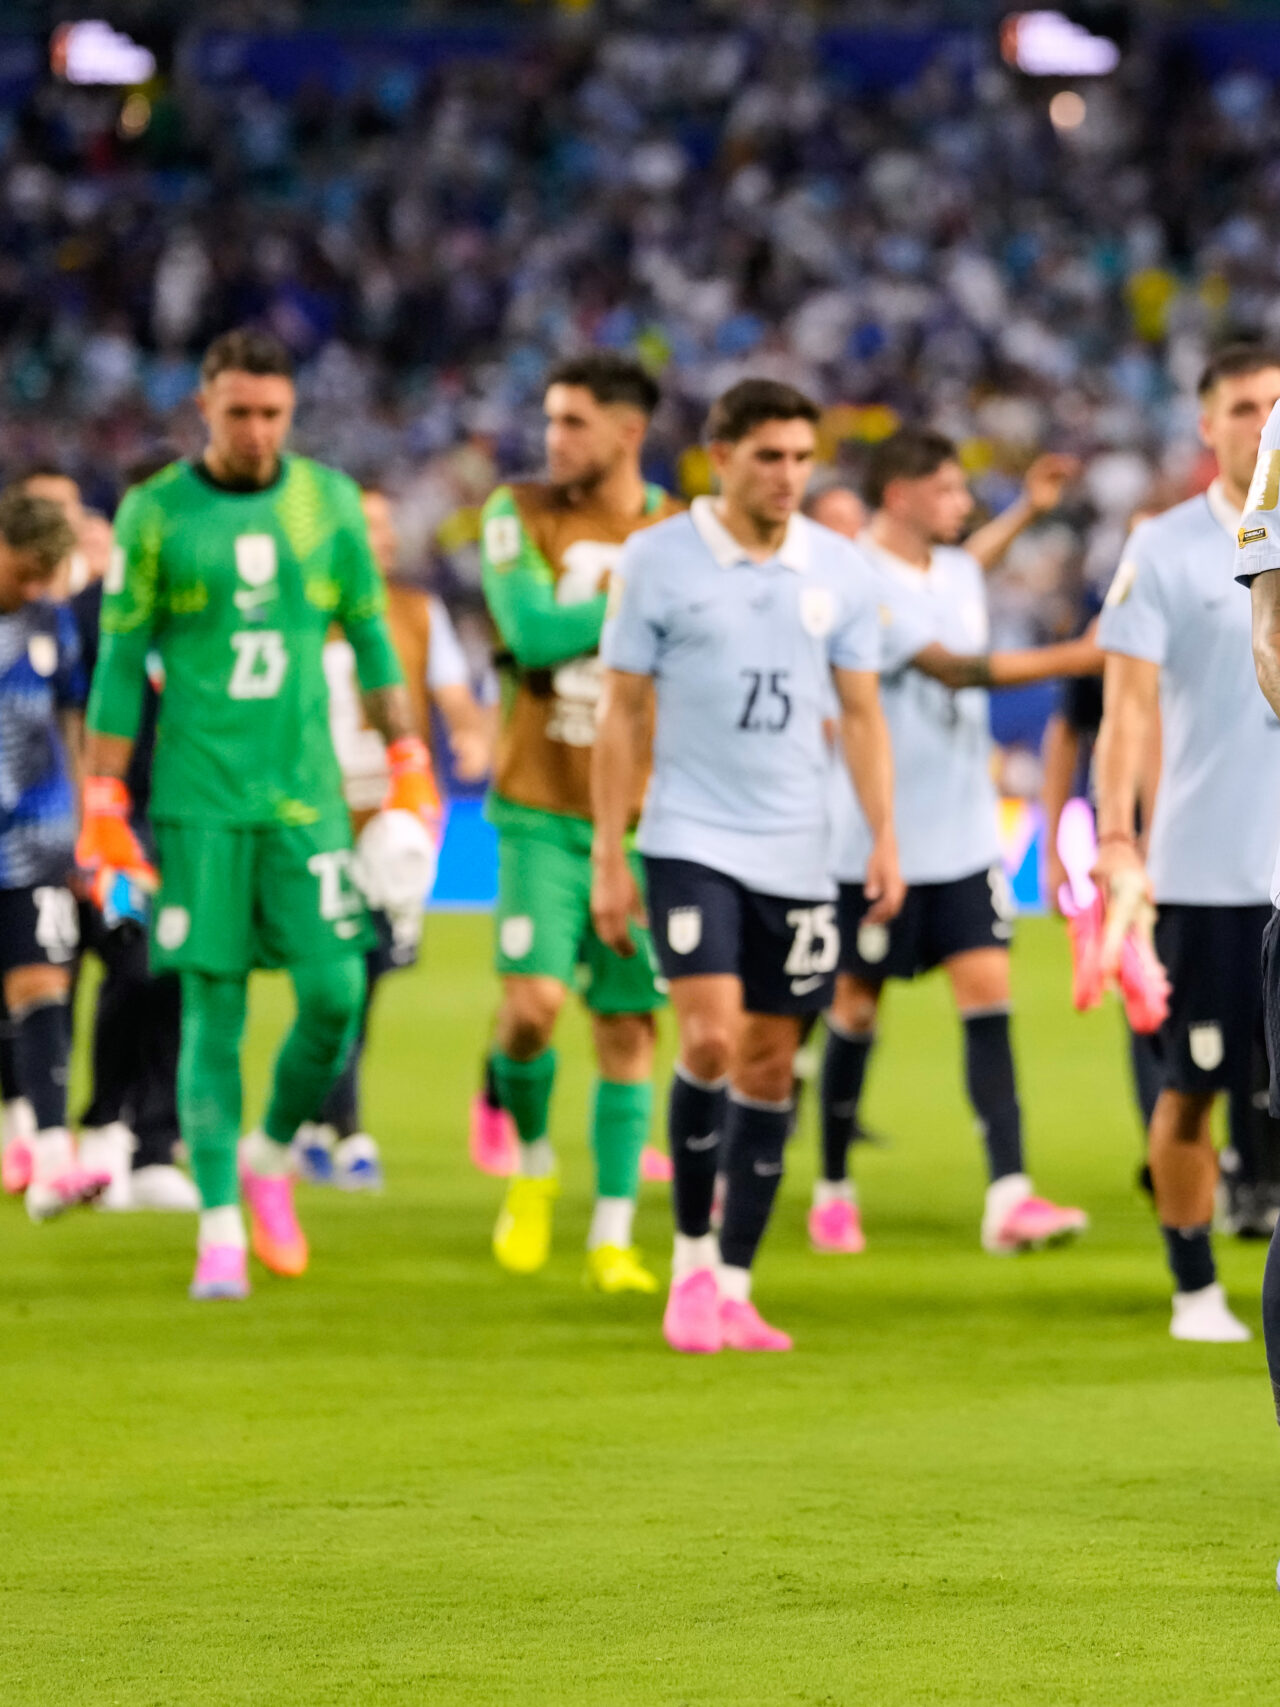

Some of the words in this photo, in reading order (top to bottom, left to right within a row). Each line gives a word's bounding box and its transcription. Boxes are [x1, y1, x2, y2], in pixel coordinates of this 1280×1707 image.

[229, 630, 289, 699] 23
[736, 666, 791, 733] 25
[783, 903, 840, 976] 25
